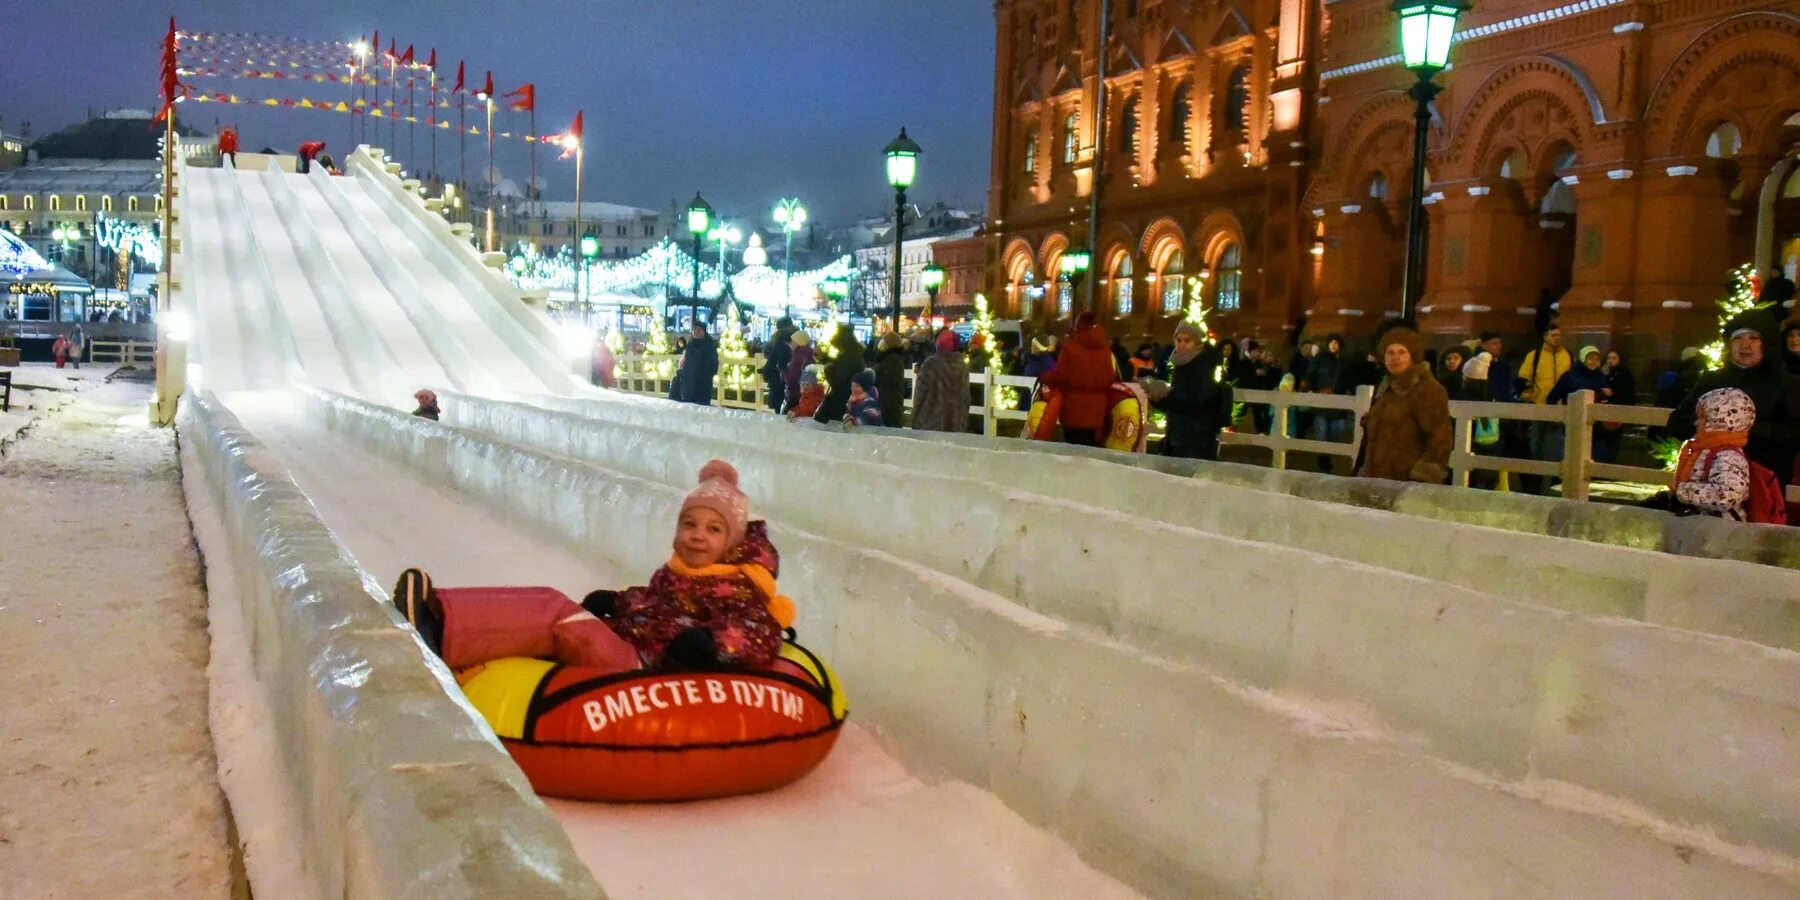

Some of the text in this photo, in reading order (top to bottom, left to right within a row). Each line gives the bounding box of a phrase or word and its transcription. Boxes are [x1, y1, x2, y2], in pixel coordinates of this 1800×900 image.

[583, 679, 804, 732] ВМЕСТЕ В ПУТИ!
